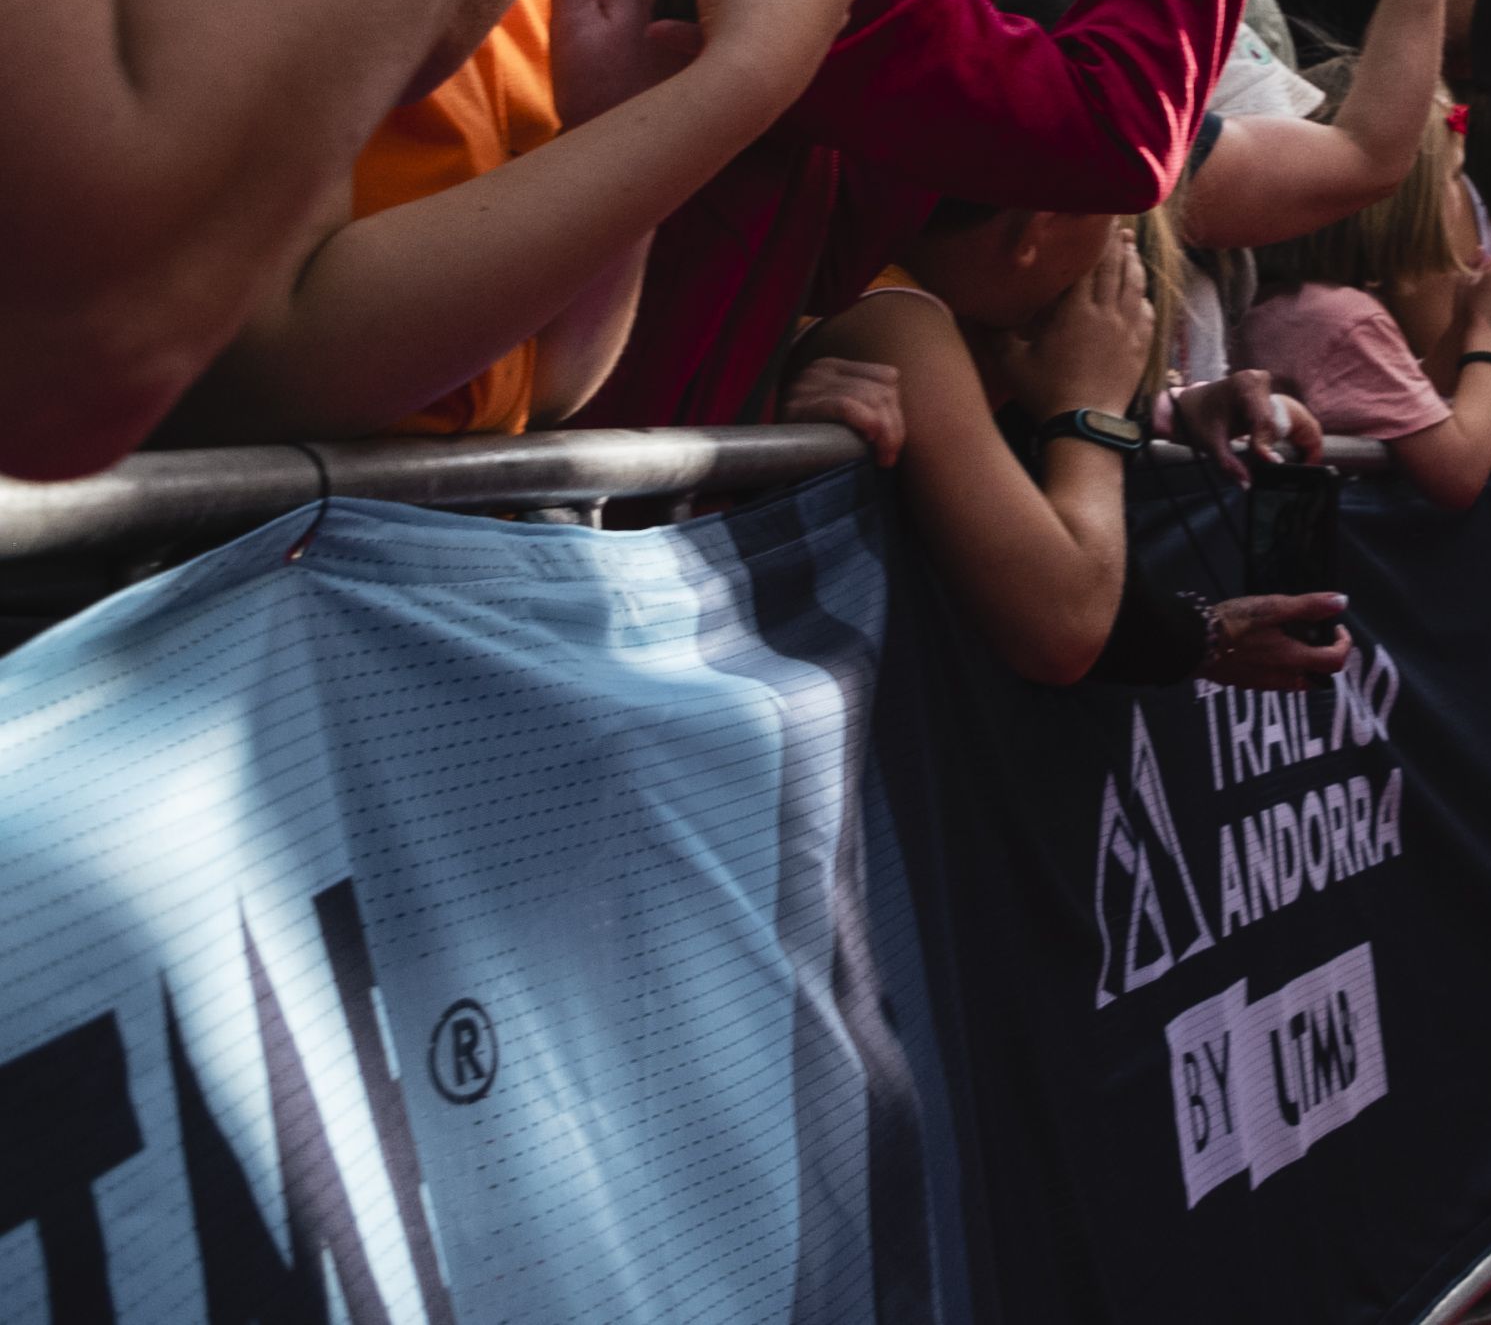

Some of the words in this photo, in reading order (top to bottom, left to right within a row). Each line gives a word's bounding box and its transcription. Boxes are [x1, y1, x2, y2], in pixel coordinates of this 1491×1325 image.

[1194, 677, 1324, 791] TRAIL
[1220, 766, 1403, 938] ANDORRA
[1182, 1030, 1235, 1155] BY
